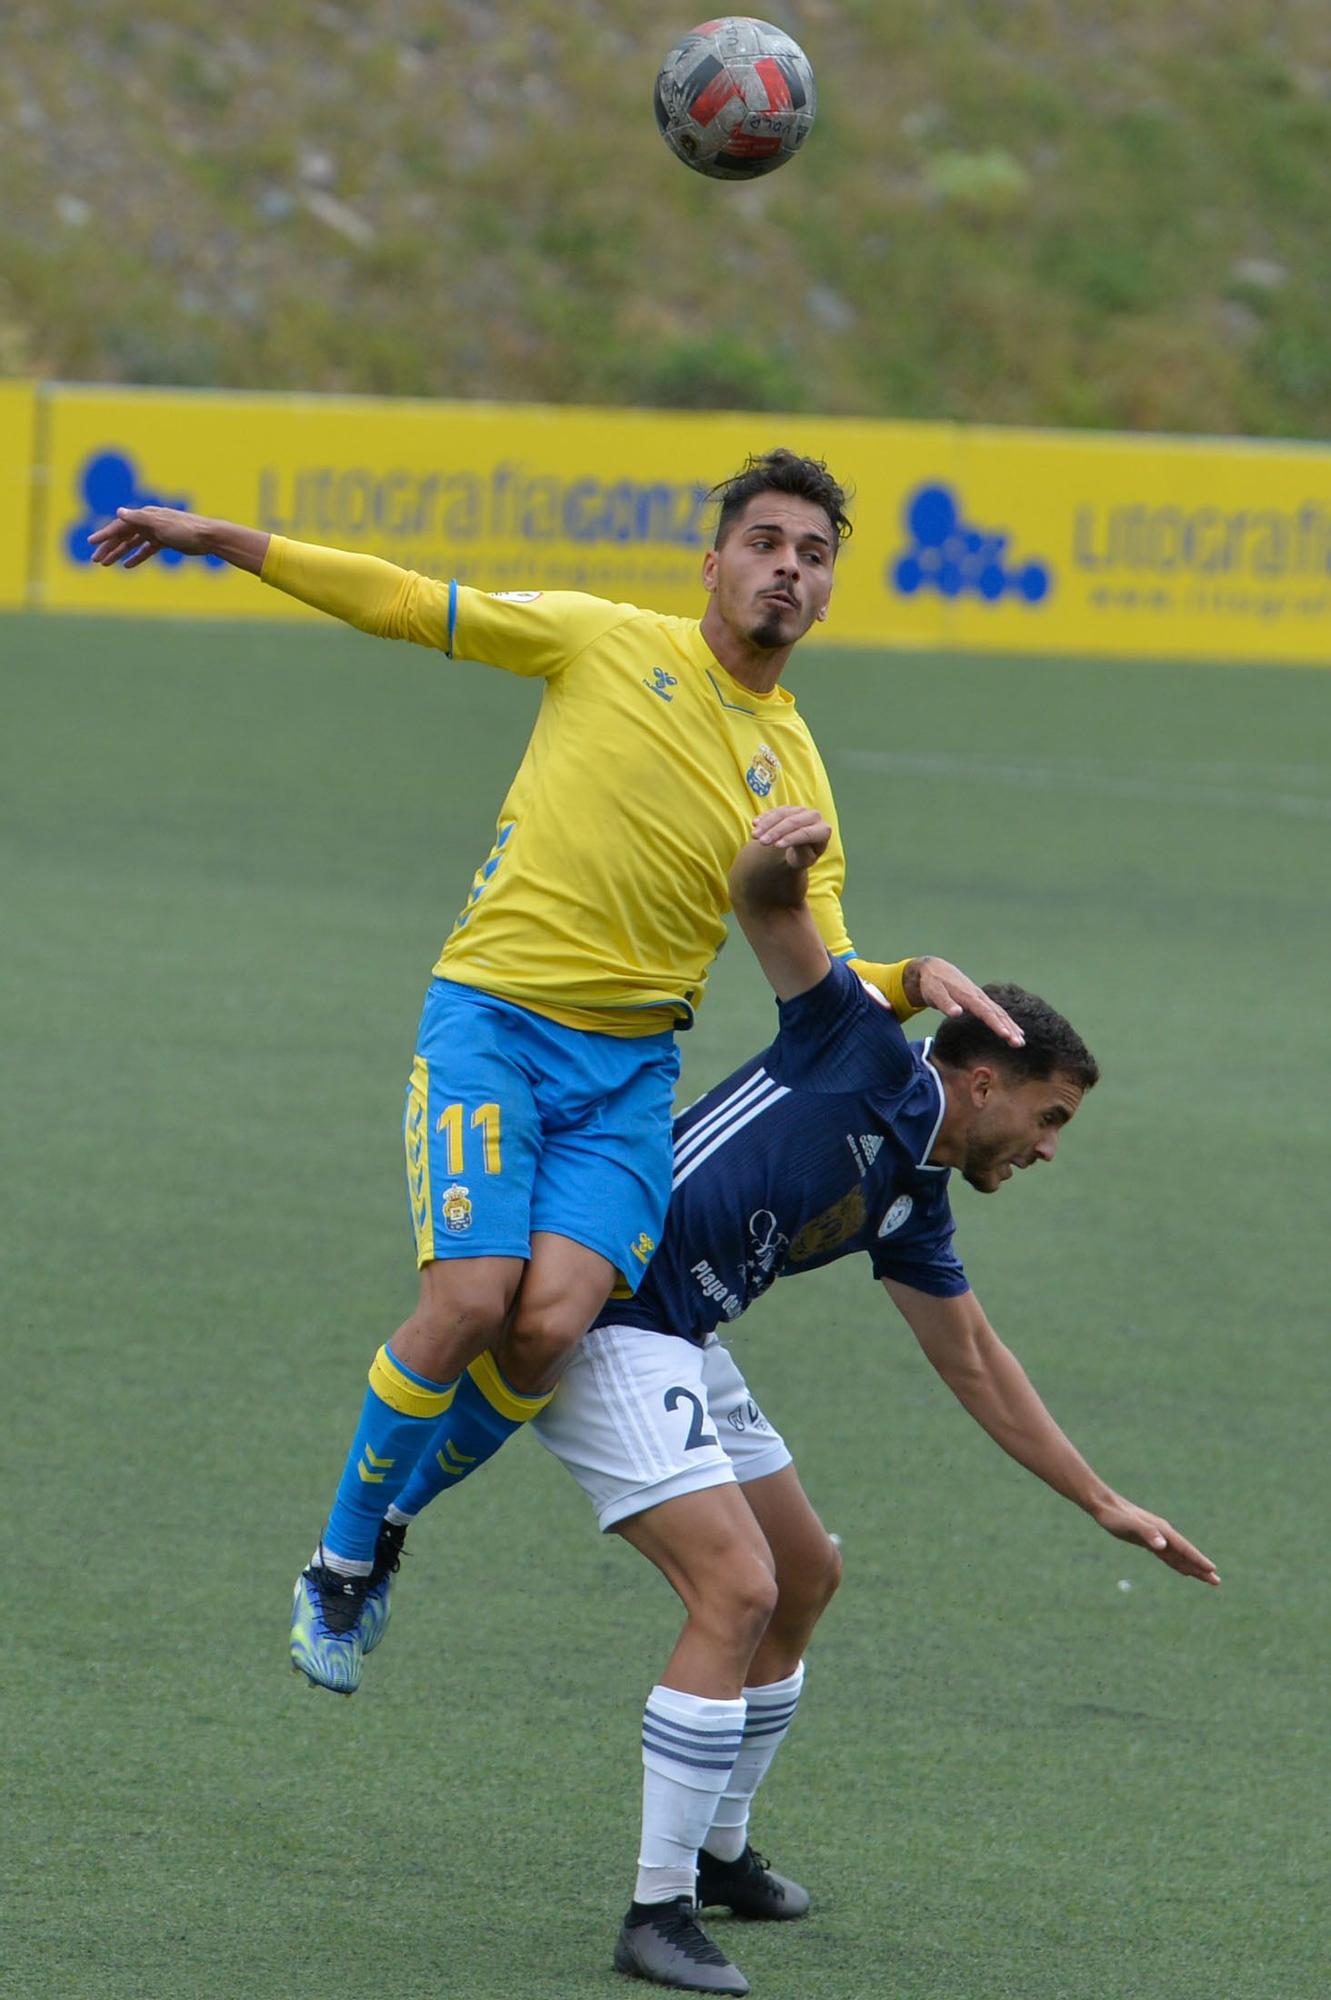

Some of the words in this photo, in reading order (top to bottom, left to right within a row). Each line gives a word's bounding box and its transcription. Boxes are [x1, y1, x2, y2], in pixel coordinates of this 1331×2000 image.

[436, 1103, 502, 1176] 11
[690, 1259, 729, 1302] Playa
[664, 1386, 718, 1451] 2
